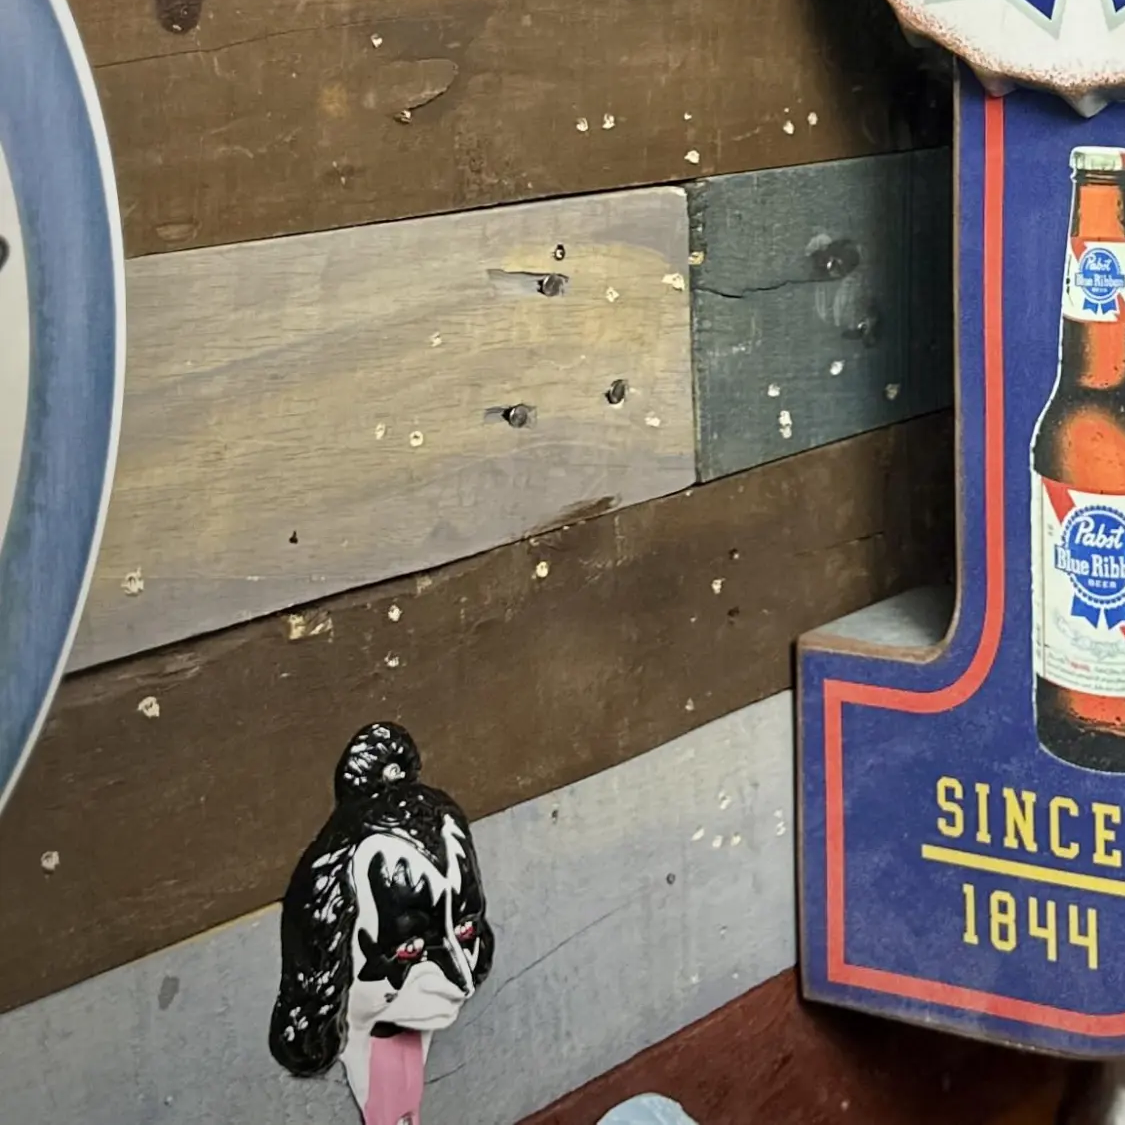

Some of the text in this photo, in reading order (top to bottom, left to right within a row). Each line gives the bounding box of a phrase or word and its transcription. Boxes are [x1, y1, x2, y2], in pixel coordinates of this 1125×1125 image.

[1057, 547, 1090, 576] Blue
[1075, 515, 1125, 549] Pabst
[936, 776, 1122, 867] SINCE
[962, 883, 1098, 970] 1844
